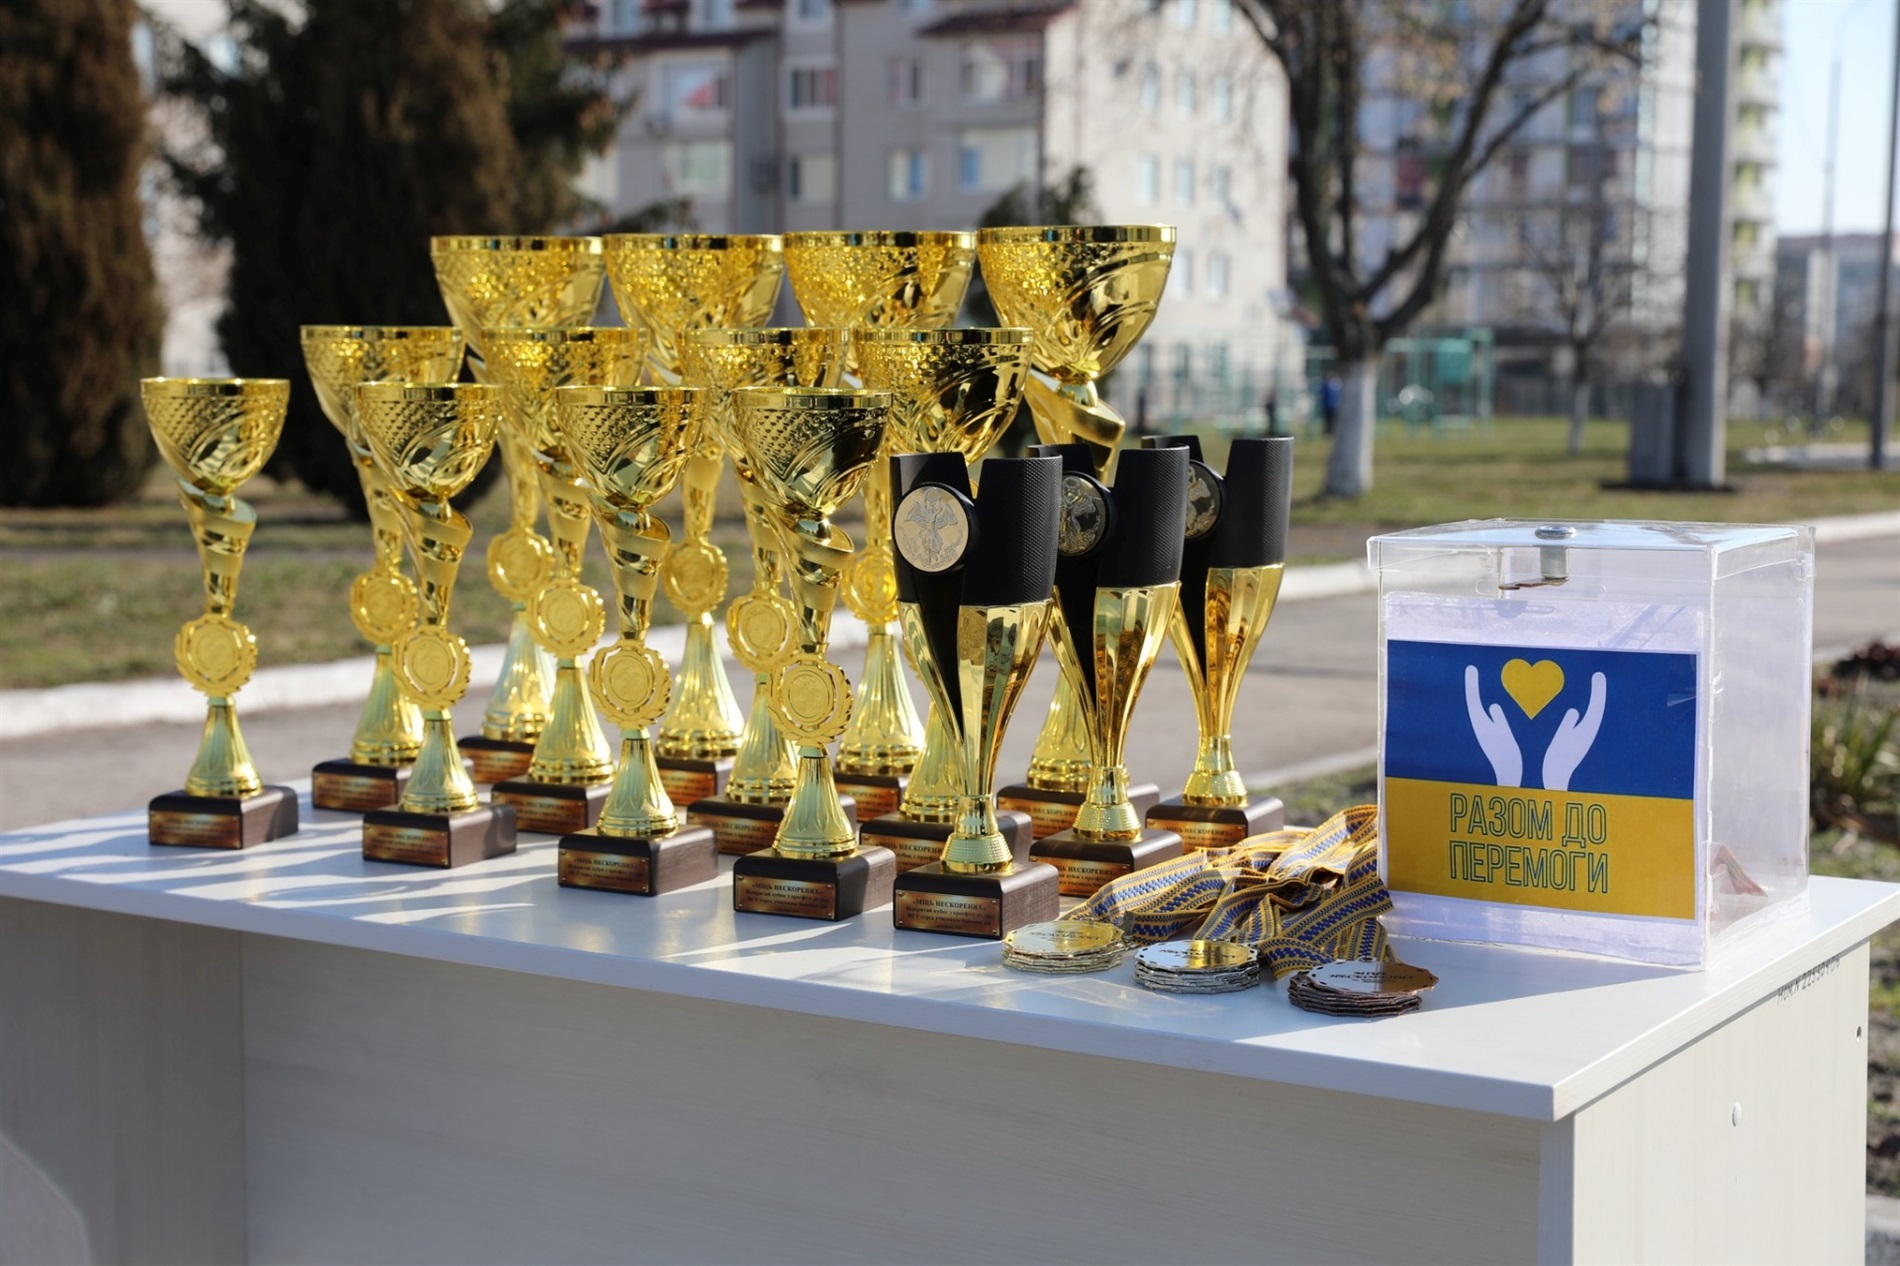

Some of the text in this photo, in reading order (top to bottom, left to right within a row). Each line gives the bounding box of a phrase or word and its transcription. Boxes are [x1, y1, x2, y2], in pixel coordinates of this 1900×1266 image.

[1450, 793, 1607, 848] РАЗОМ ДО
[1449, 840, 1608, 894] ПЕРЕМОГИ
